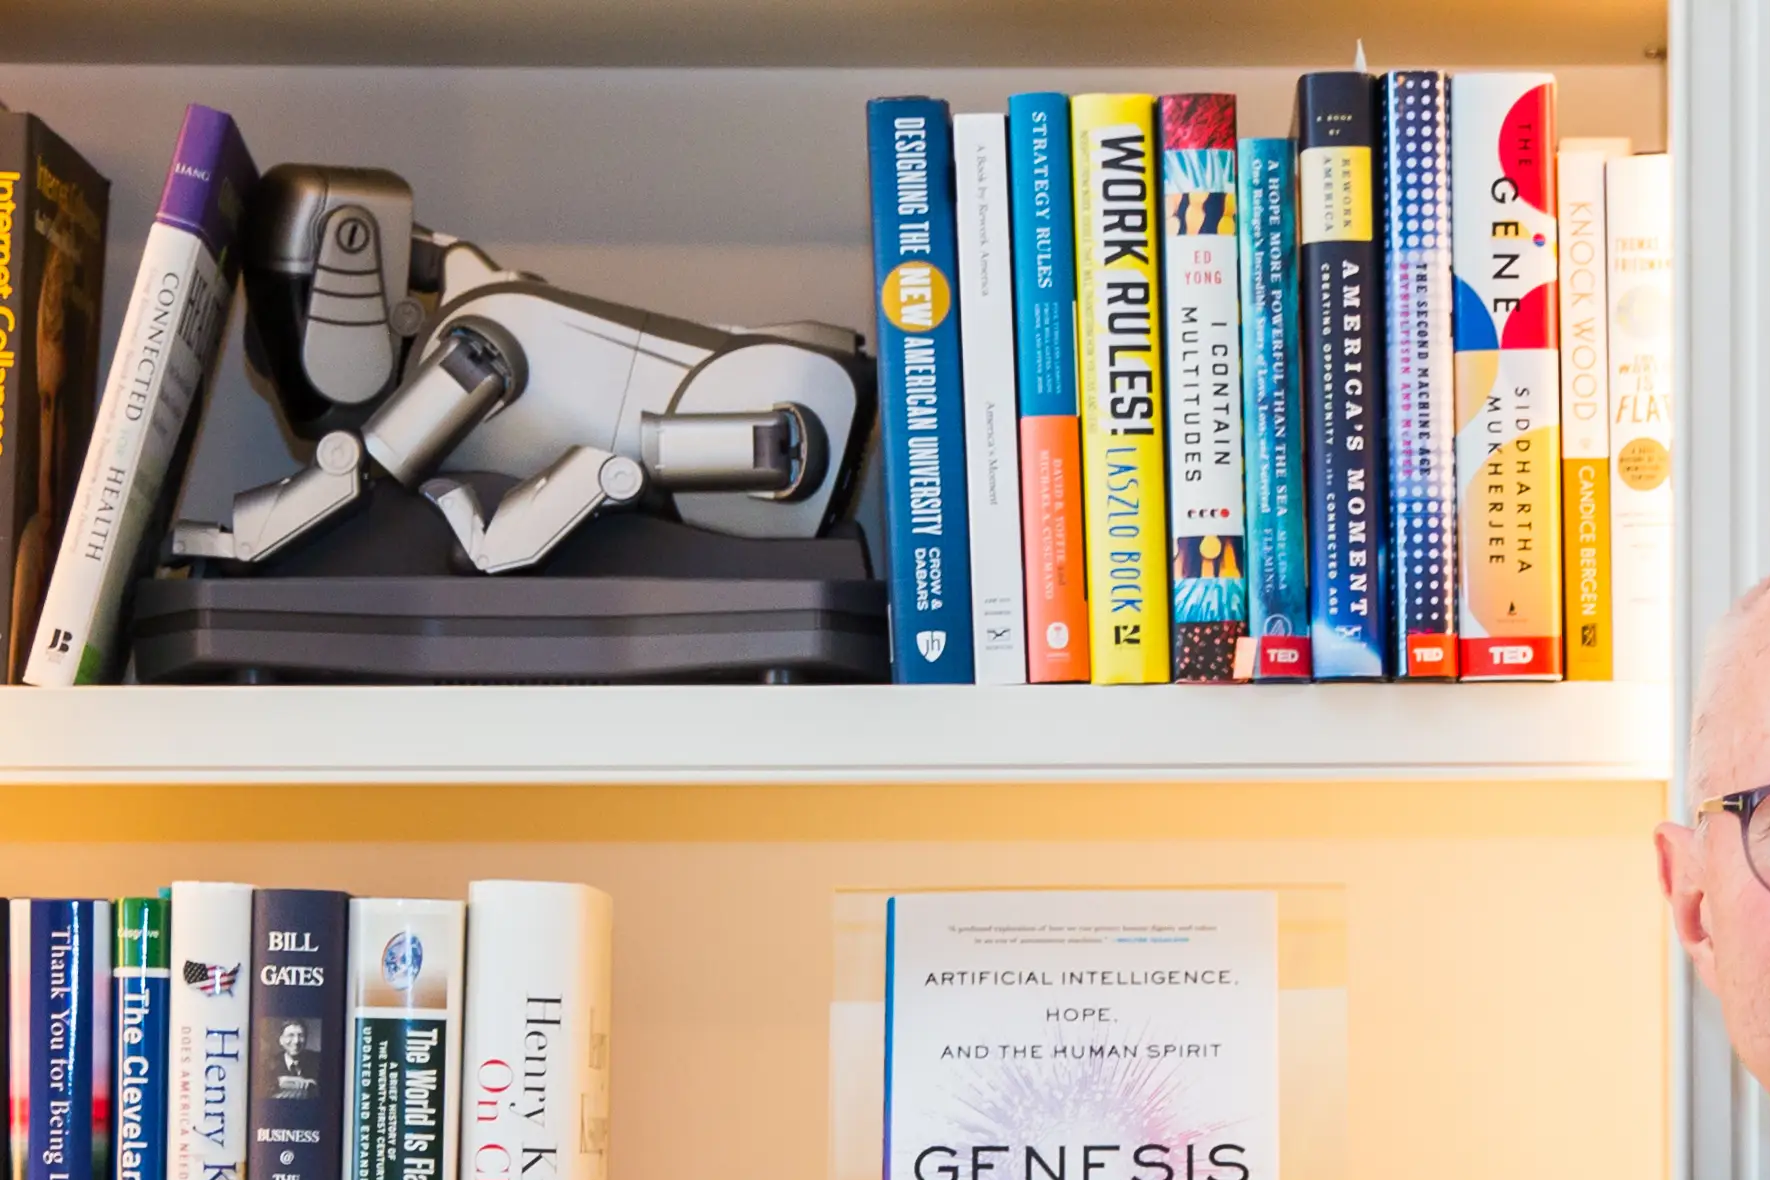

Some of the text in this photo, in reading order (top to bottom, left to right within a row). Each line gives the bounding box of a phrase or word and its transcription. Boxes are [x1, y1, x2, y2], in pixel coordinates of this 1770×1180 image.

[1032, 111, 1049, 219] STRATEGY
[1491, 123, 1532, 314] THE GENE
[1036, 227, 1053, 289] RULES
[894, 116, 943, 535] DESIGNING THE NEW AMERICAN UNIVERSITY
[1100, 135, 1153, 614] WORK RULES! LASZLO BOCK
[1180, 306, 1201, 483] MULTITUDES
[1212, 340, 1230, 466] CONTAIN
[84, 271, 181, 562] CONNECTED HEALTH
[1343, 260, 1369, 616] AMERICA'S MOMENT
[1485, 395, 1504, 566] MUKHERJEE
[1515, 387, 1532, 575] SIDDHARTHA
[1577, 465, 1597, 616] CANDICE BERGEN
[51, 926, 72, 1000] Thank
[268, 932, 319, 951] BILL
[260, 966, 324, 987] GATES
[924, 970, 1239, 986] ARTIFICIAL INTELLIGENCE,
[50, 1014, 71, 1051] You
[123, 989, 150, 1045] The
[406, 1028, 438, 1063] The
[1046, 1008, 1118, 1022] HOPE,
[48, 1058, 67, 1093] for
[510, 996, 562, 1127] Henry
[941, 1044, 1222, 1059] AND THE HUMAN SPIRIT
[193, 1027, 240, 1148] Henry
[404, 1068, 437, 1132] World
[477, 1059, 514, 1123] On
[44, 1099, 70, 1165] Being
[257, 1129, 319, 1142] BUSINESS
[403, 1134, 434, 1151] Is
